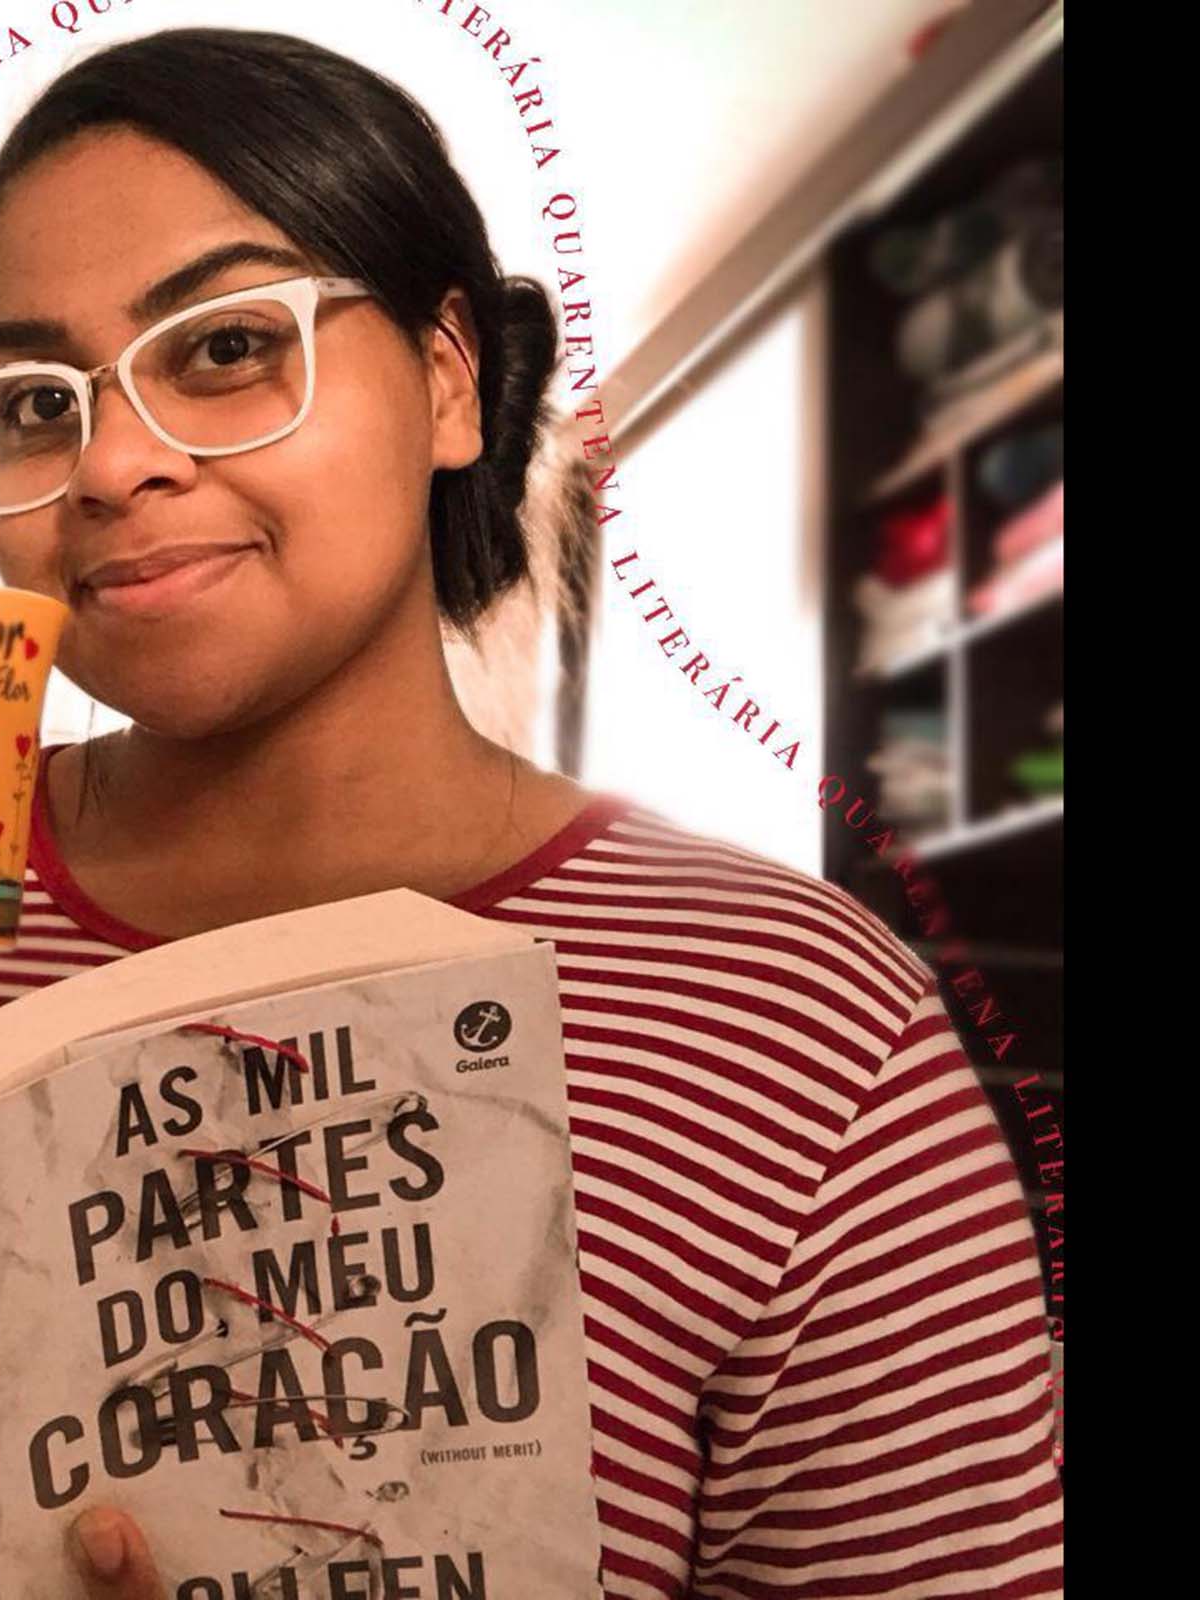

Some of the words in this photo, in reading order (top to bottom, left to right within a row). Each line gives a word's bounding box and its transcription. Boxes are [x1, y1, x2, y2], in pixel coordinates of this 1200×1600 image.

[115, 1066, 203, 1158] AS
[242, 1025, 376, 1116] MIL
[456, 1055, 510, 1073] Galera
[68, 1111, 445, 1286] PARTES
[96, 1269, 203, 1368] DO
[252, 1222, 436, 1324] MEU
[28, 1308, 540, 1510] CORAÇÃO
[420, 1446, 487, 1465] (WITHOUT
[492, 1438, 542, 1459] MERIT)
